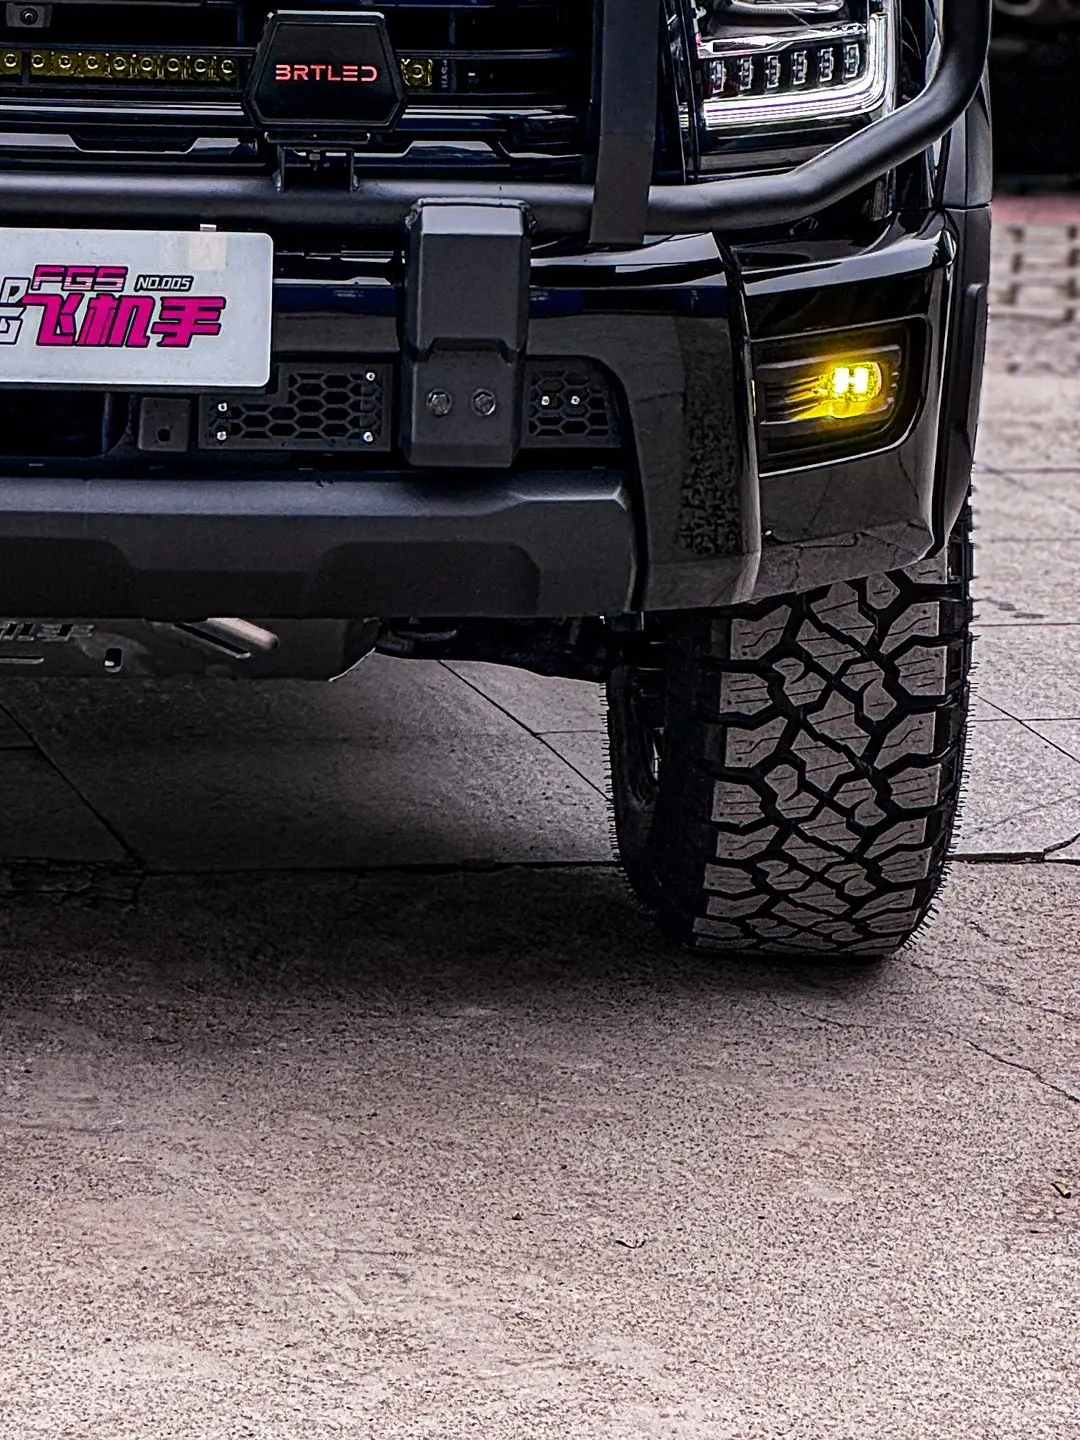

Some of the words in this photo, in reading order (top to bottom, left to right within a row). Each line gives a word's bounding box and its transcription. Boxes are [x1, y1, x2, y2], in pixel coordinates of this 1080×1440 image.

[275, 64, 378, 82] BRTLED
[134, 275, 194, 292] NO.005
[21, 293, 226, 347] 飞机手
